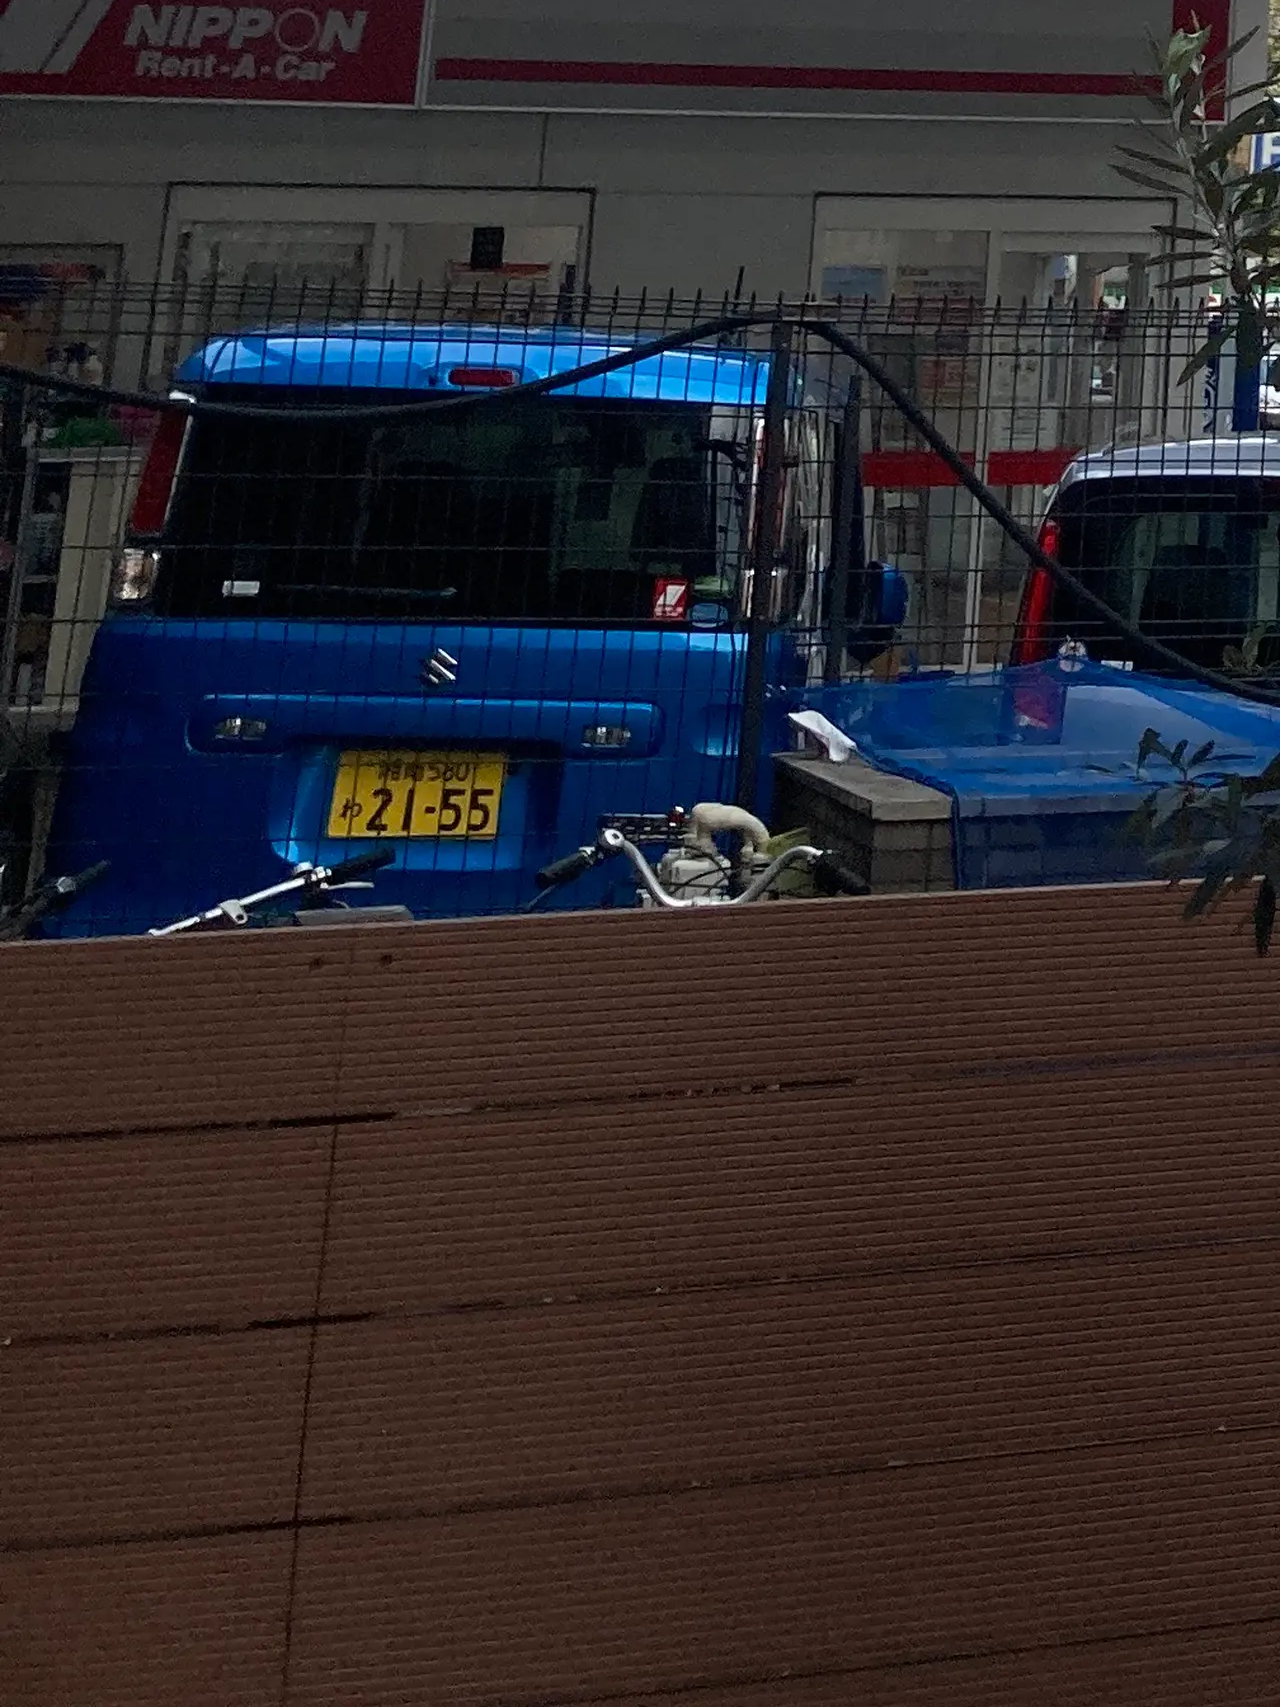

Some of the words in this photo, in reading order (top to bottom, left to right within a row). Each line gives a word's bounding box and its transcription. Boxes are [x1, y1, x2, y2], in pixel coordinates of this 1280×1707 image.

[123, 5, 368, 53] NIPPON
[135, 50, 336, 81] Rent-A-Car
[365, 788, 494, 832] 21-55
